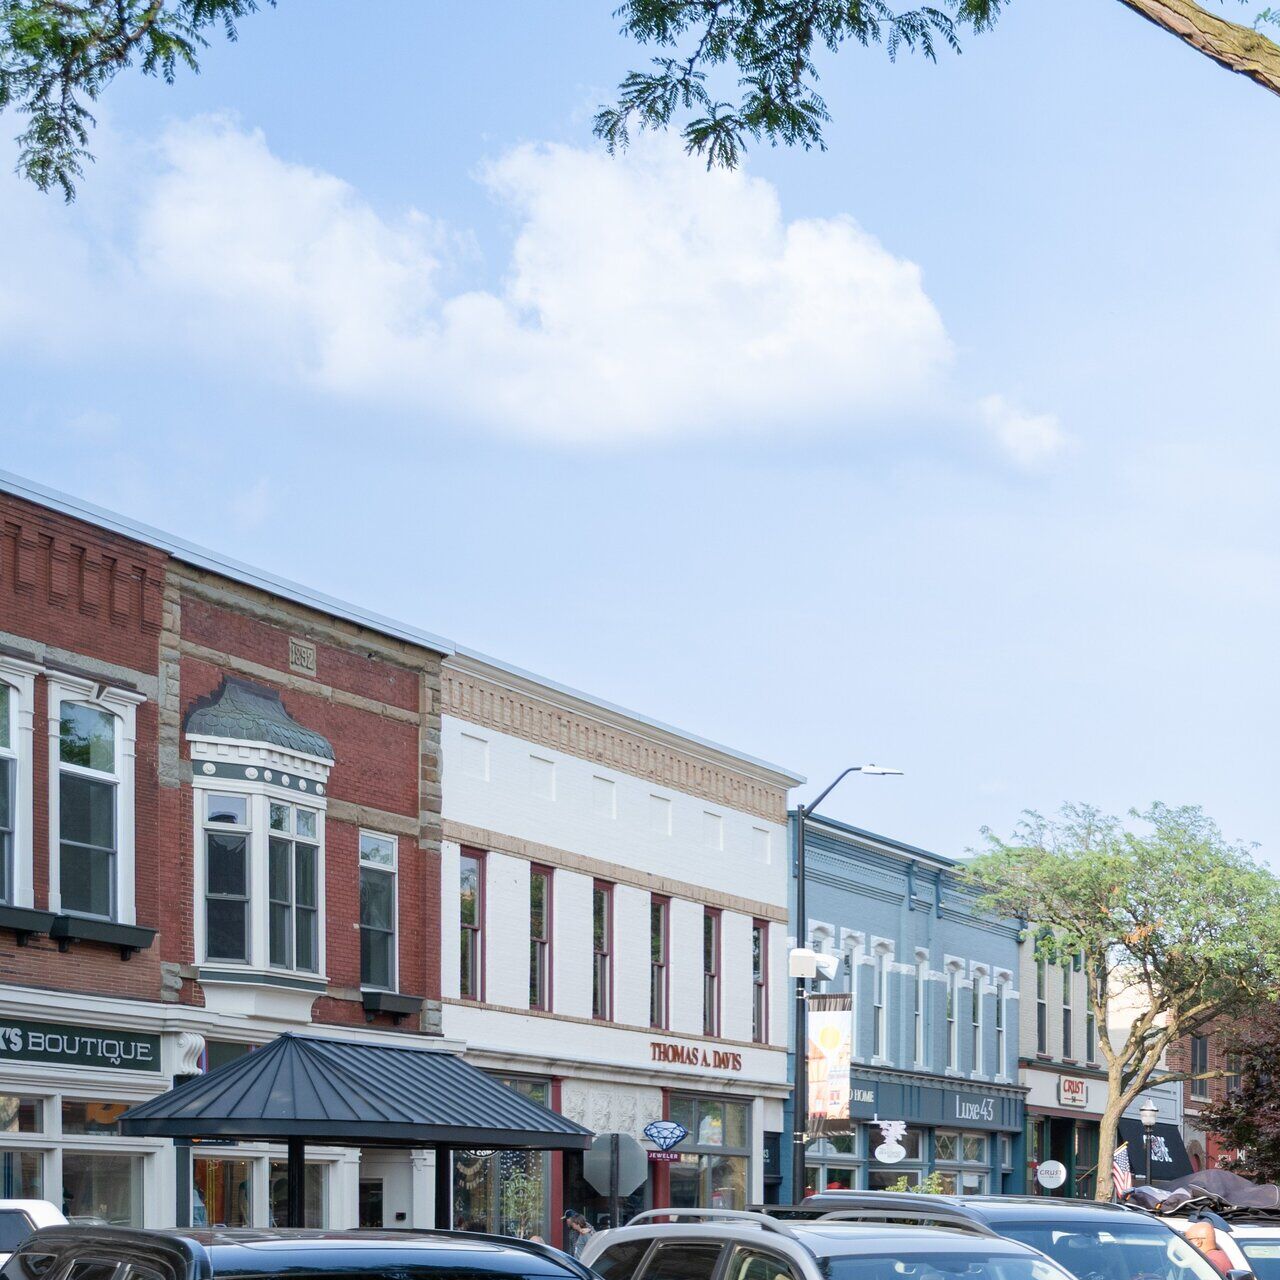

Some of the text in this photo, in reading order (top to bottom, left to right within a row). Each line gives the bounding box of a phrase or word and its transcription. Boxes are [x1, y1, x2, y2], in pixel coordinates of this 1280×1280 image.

[27, 1031, 153, 1065] BOUTIQUE
[650, 1042, 742, 1071] THOMAS A. DAVIS
[854, 1088, 875, 1103] HOME
[1063, 1079, 1085, 1095] CRUST
